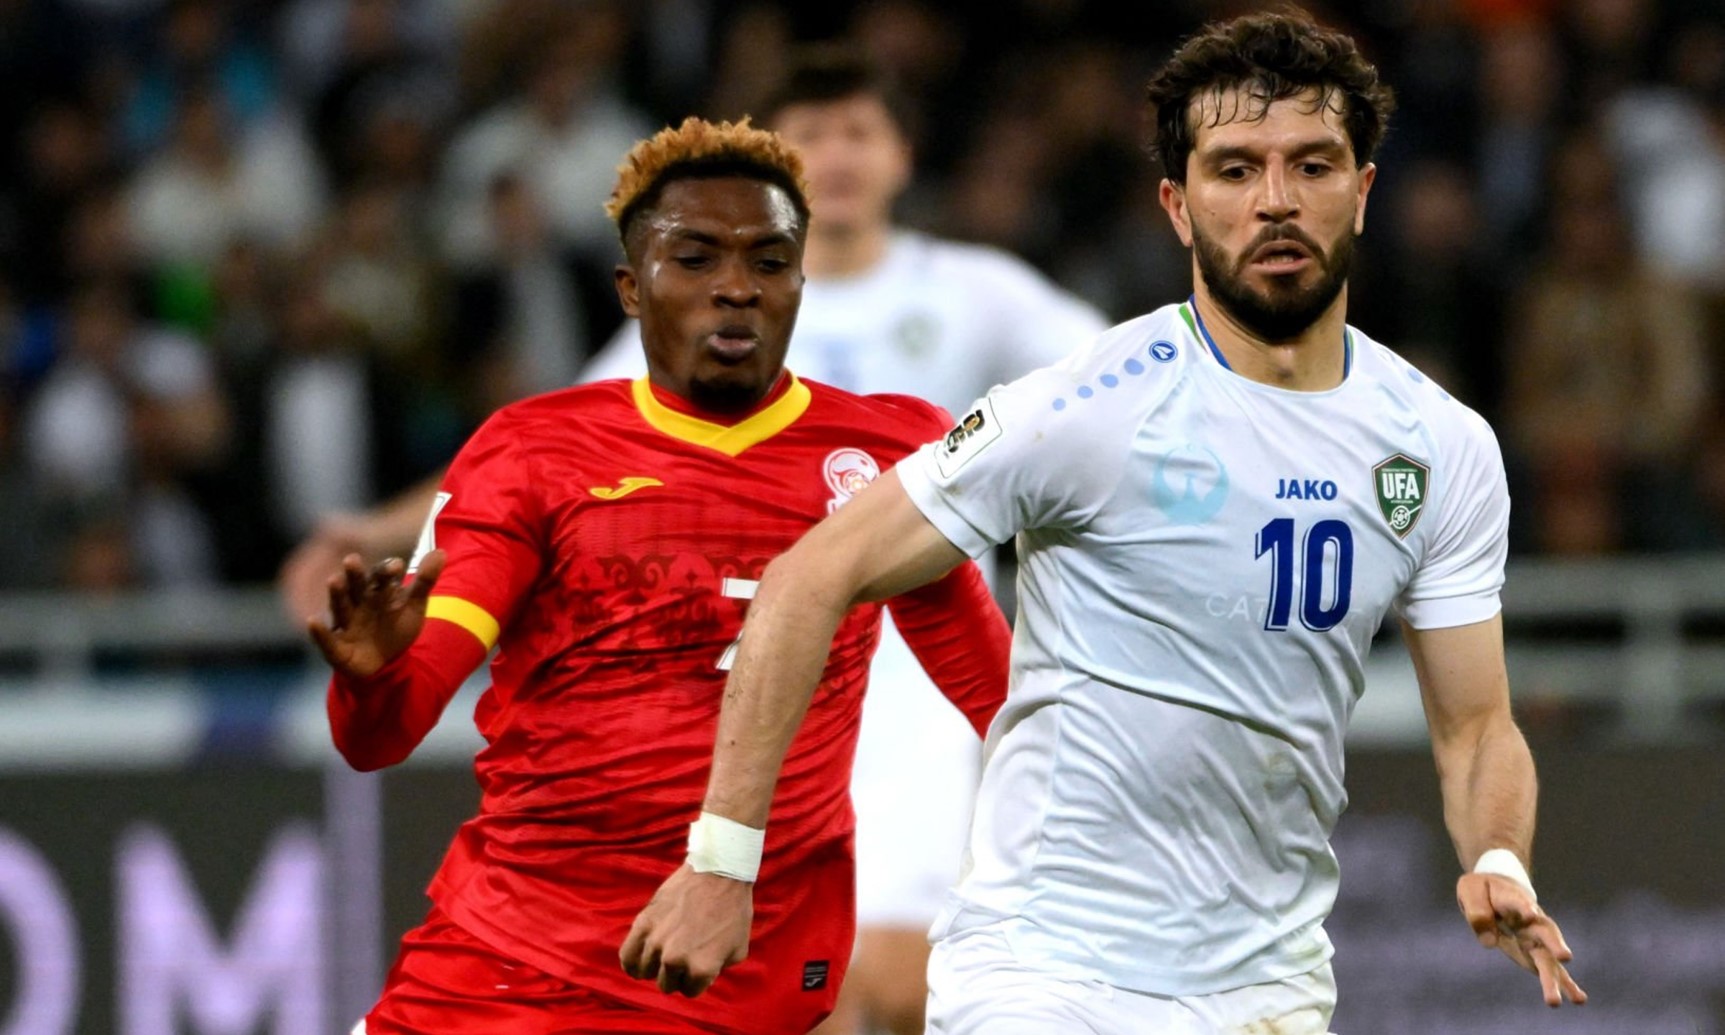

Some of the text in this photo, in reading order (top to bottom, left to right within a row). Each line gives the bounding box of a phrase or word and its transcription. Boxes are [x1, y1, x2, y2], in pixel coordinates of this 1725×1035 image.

[1275, 479, 1338, 500] JAKO
[1382, 473, 1420, 499] UFA
[1255, 518, 1354, 632] 10
